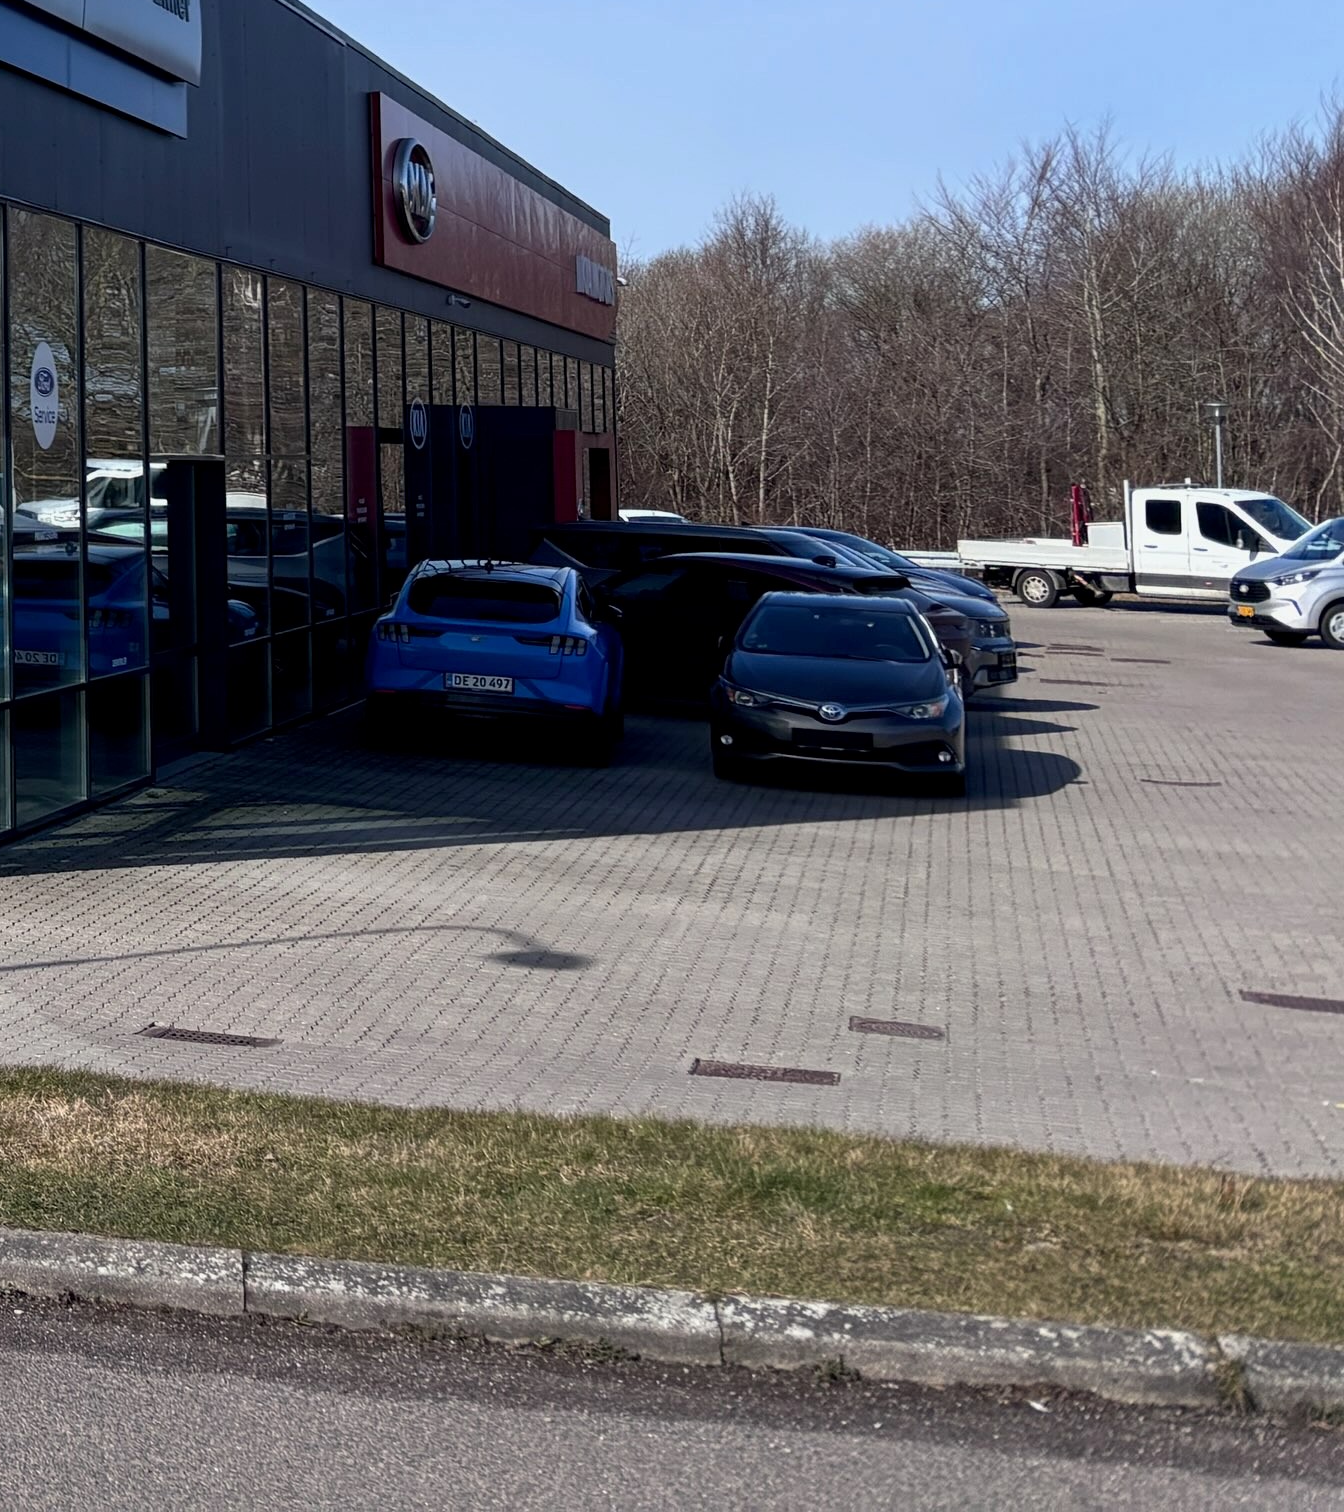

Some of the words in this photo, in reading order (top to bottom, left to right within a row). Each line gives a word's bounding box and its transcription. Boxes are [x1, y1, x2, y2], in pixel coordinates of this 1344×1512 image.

[34, 406, 56, 424] Service
[454, 675, 470, 687] DE
[472, 676, 487, 688] 20
[489, 678, 510, 689] 497
